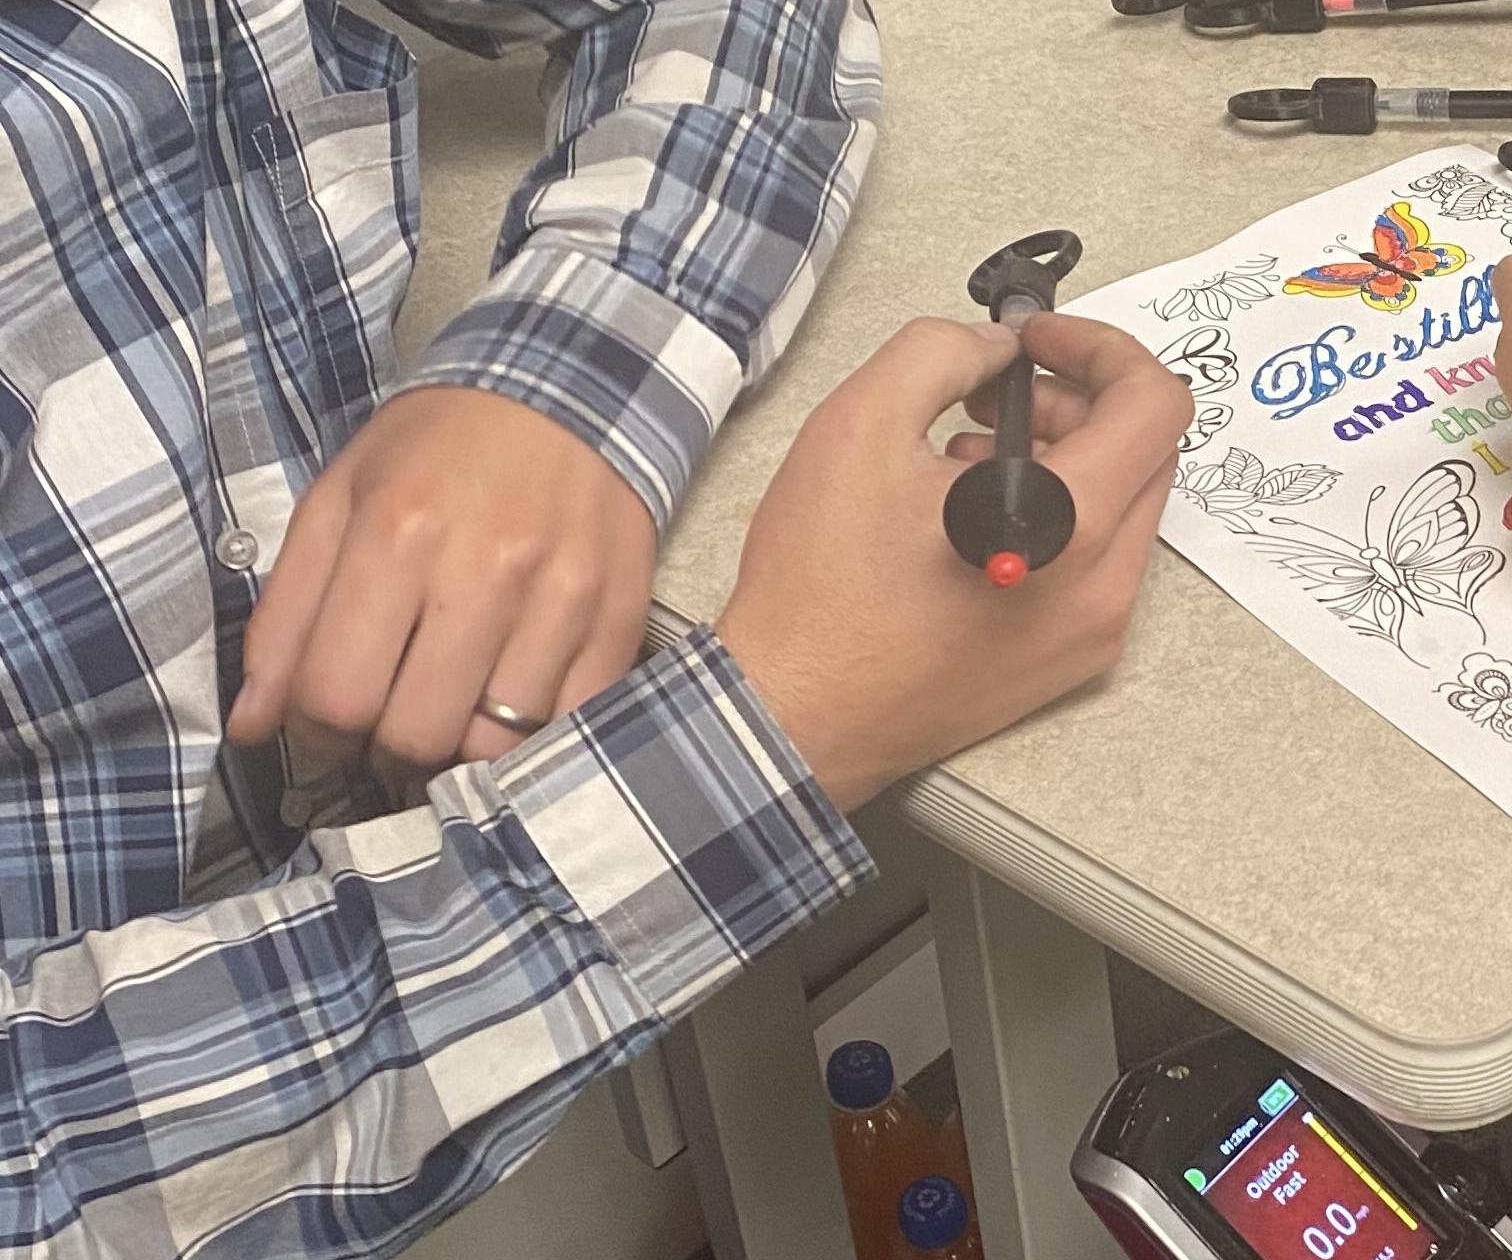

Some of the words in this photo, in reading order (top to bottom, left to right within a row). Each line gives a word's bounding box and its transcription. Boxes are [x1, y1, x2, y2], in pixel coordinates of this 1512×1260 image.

[1251, 325, 1387, 421] Be
[1333, 379, 1435, 442] and
[1424, 354, 1497, 396] kn
[1430, 395, 1512, 444] tha
[1471, 441, 1511, 476] I
[1246, 1144, 1300, 1200] Outdoor
[1272, 1170, 1308, 1206] Fast
[1302, 1202, 1357, 1260] 0.0
